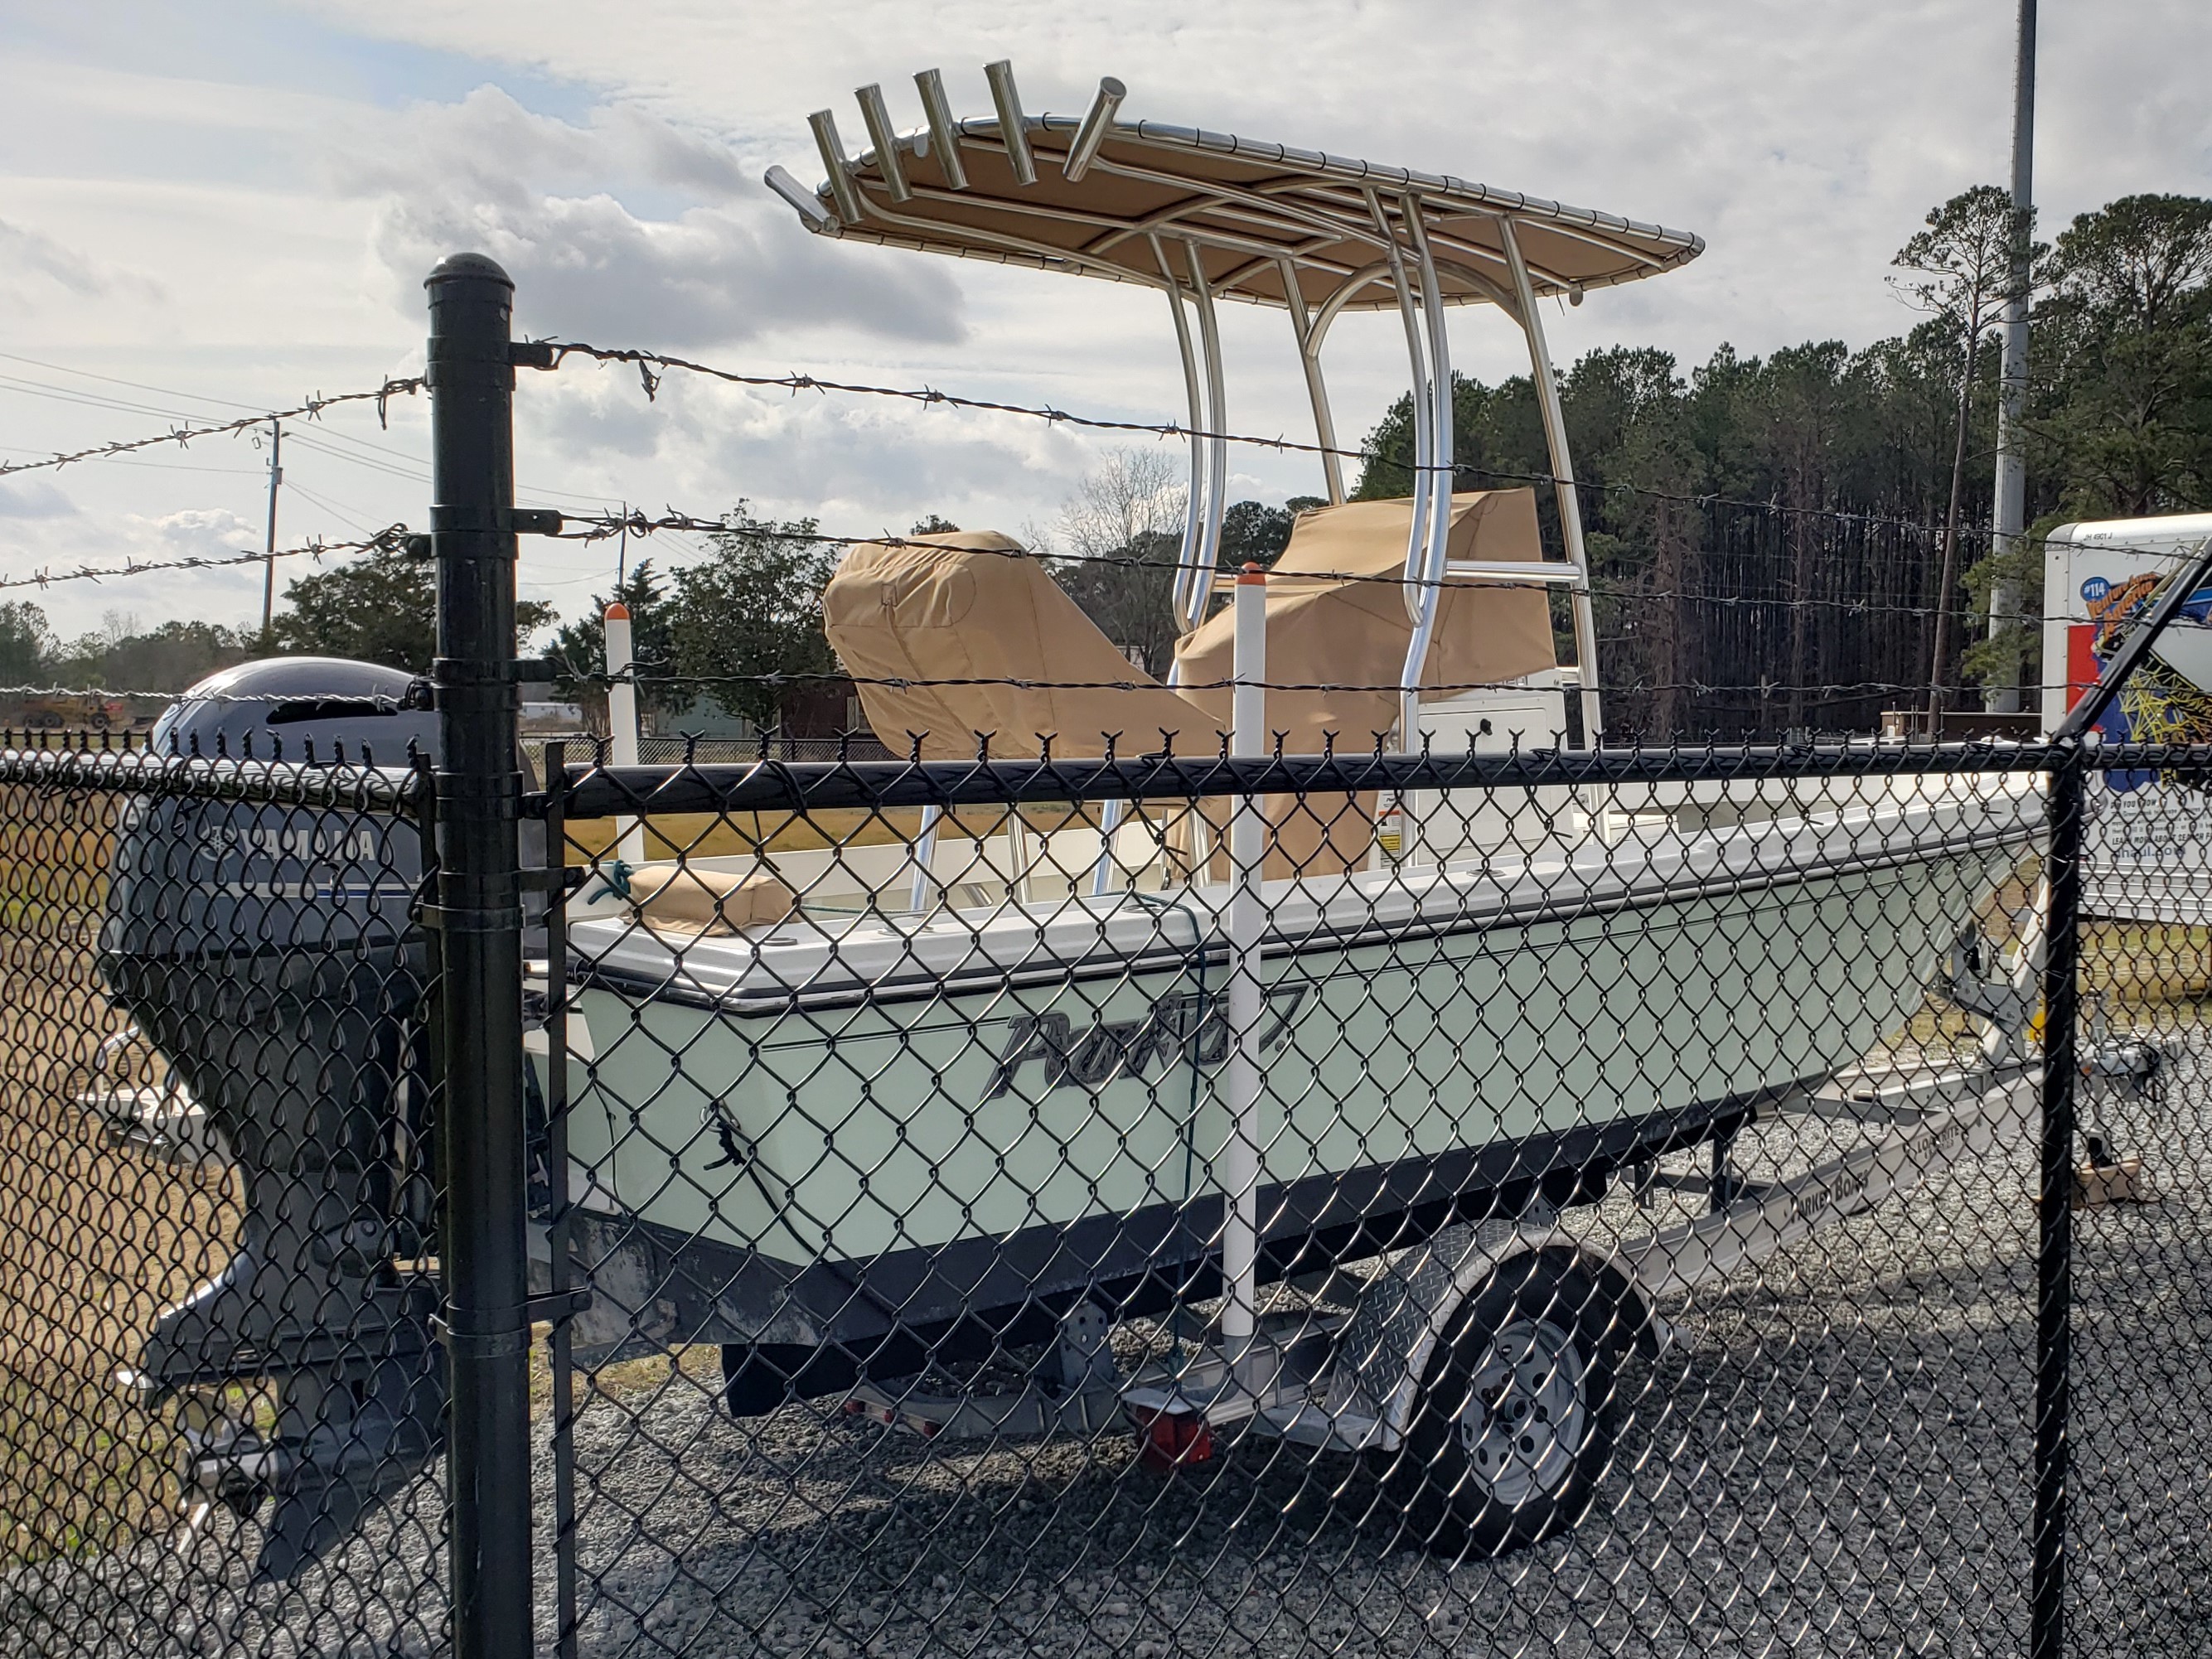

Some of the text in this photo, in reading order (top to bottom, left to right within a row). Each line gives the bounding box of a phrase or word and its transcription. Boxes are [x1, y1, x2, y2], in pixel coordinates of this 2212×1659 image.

[2084, 583, 2105, 597] #114
[2086, 583, 2131, 620] Venture
[2103, 581, 2154, 641] America
[2123, 800, 2137, 809] YOU
[2134, 834, 2151, 844] MOR
[2178, 832, 2205, 842] SEACH
[2113, 846, 2185, 859] uhaul.om
[980, 986, 1310, 1100] Parke
[1917, 1126, 1959, 1154] LOARITE
[1790, 1188, 1832, 1224] PARKE
